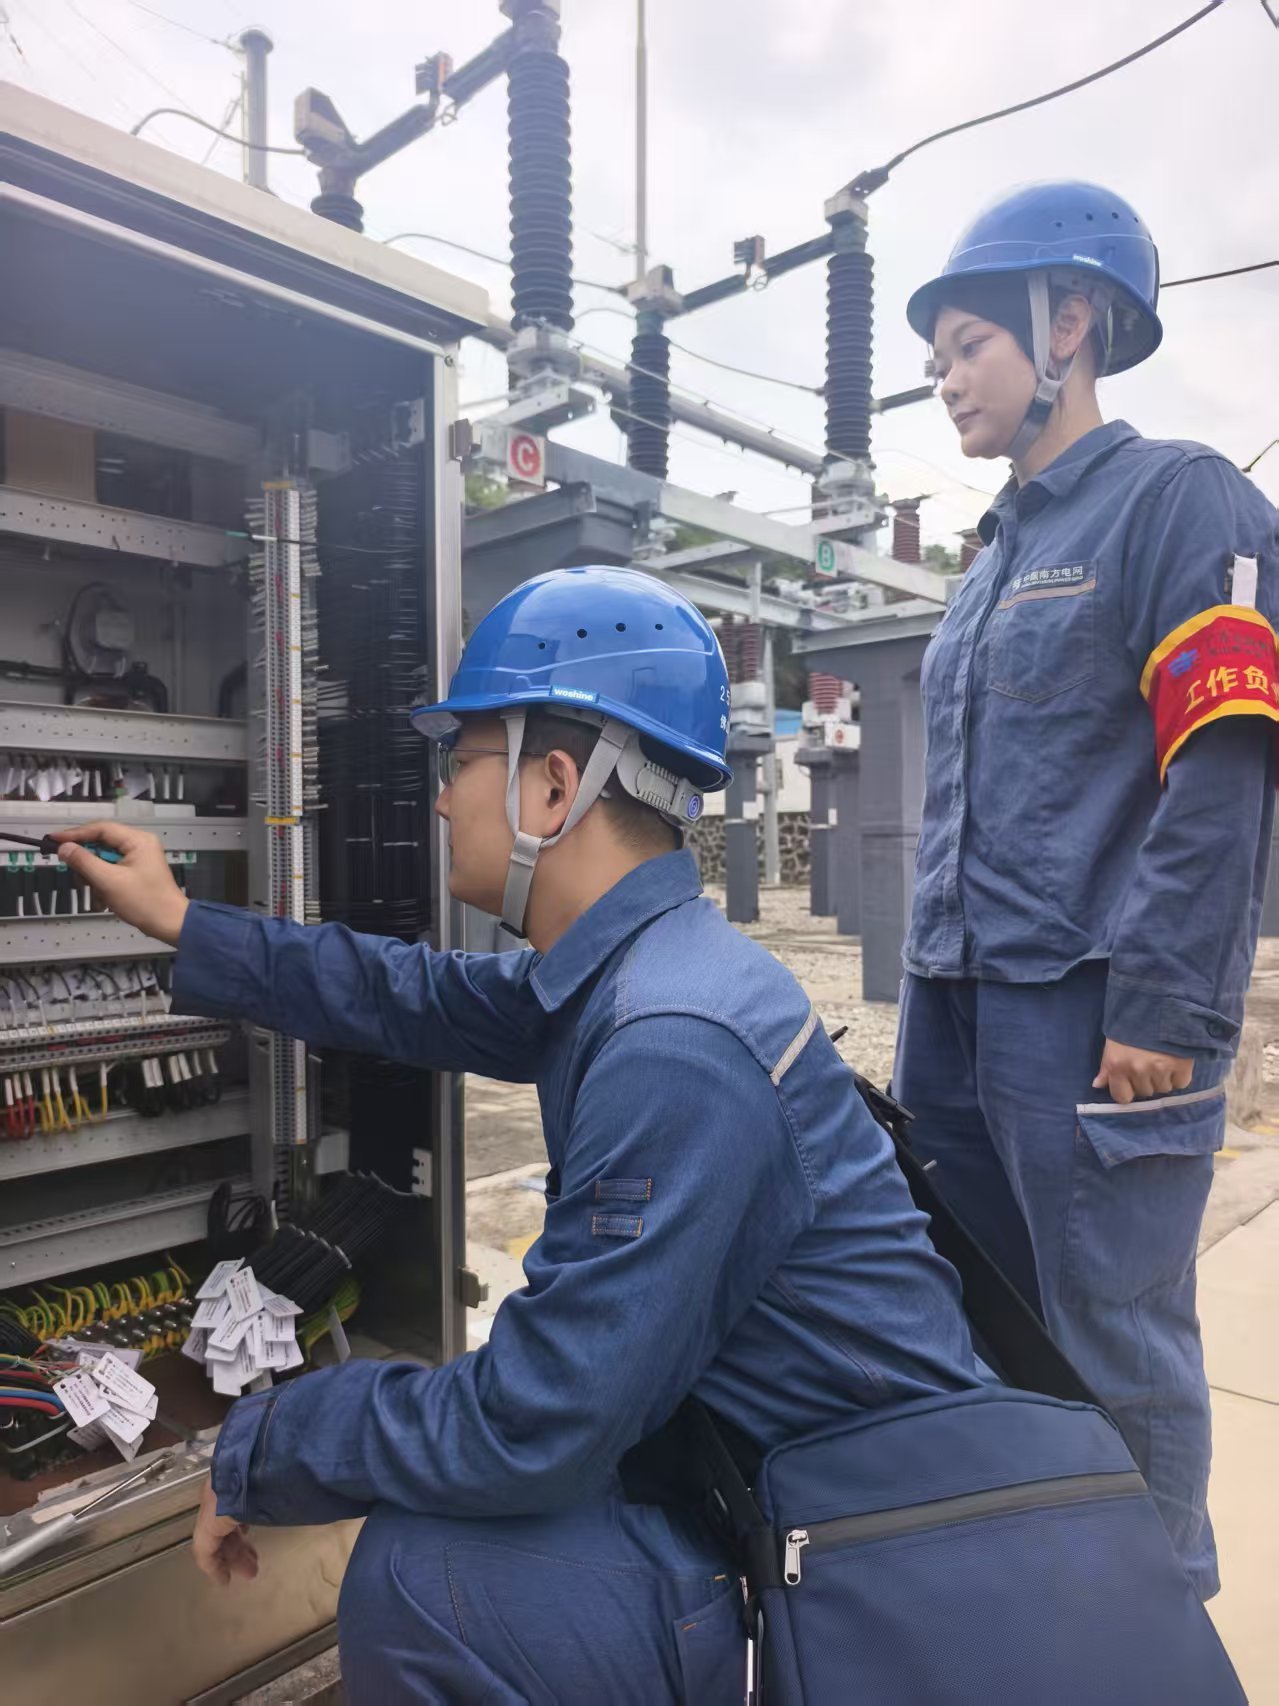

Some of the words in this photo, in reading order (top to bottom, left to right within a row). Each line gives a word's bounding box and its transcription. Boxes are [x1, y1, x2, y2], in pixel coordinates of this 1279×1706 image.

[516, 441, 536, 473] C
[554, 688, 594, 701] woshine
[1184, 666, 1279, 714] 工作负
